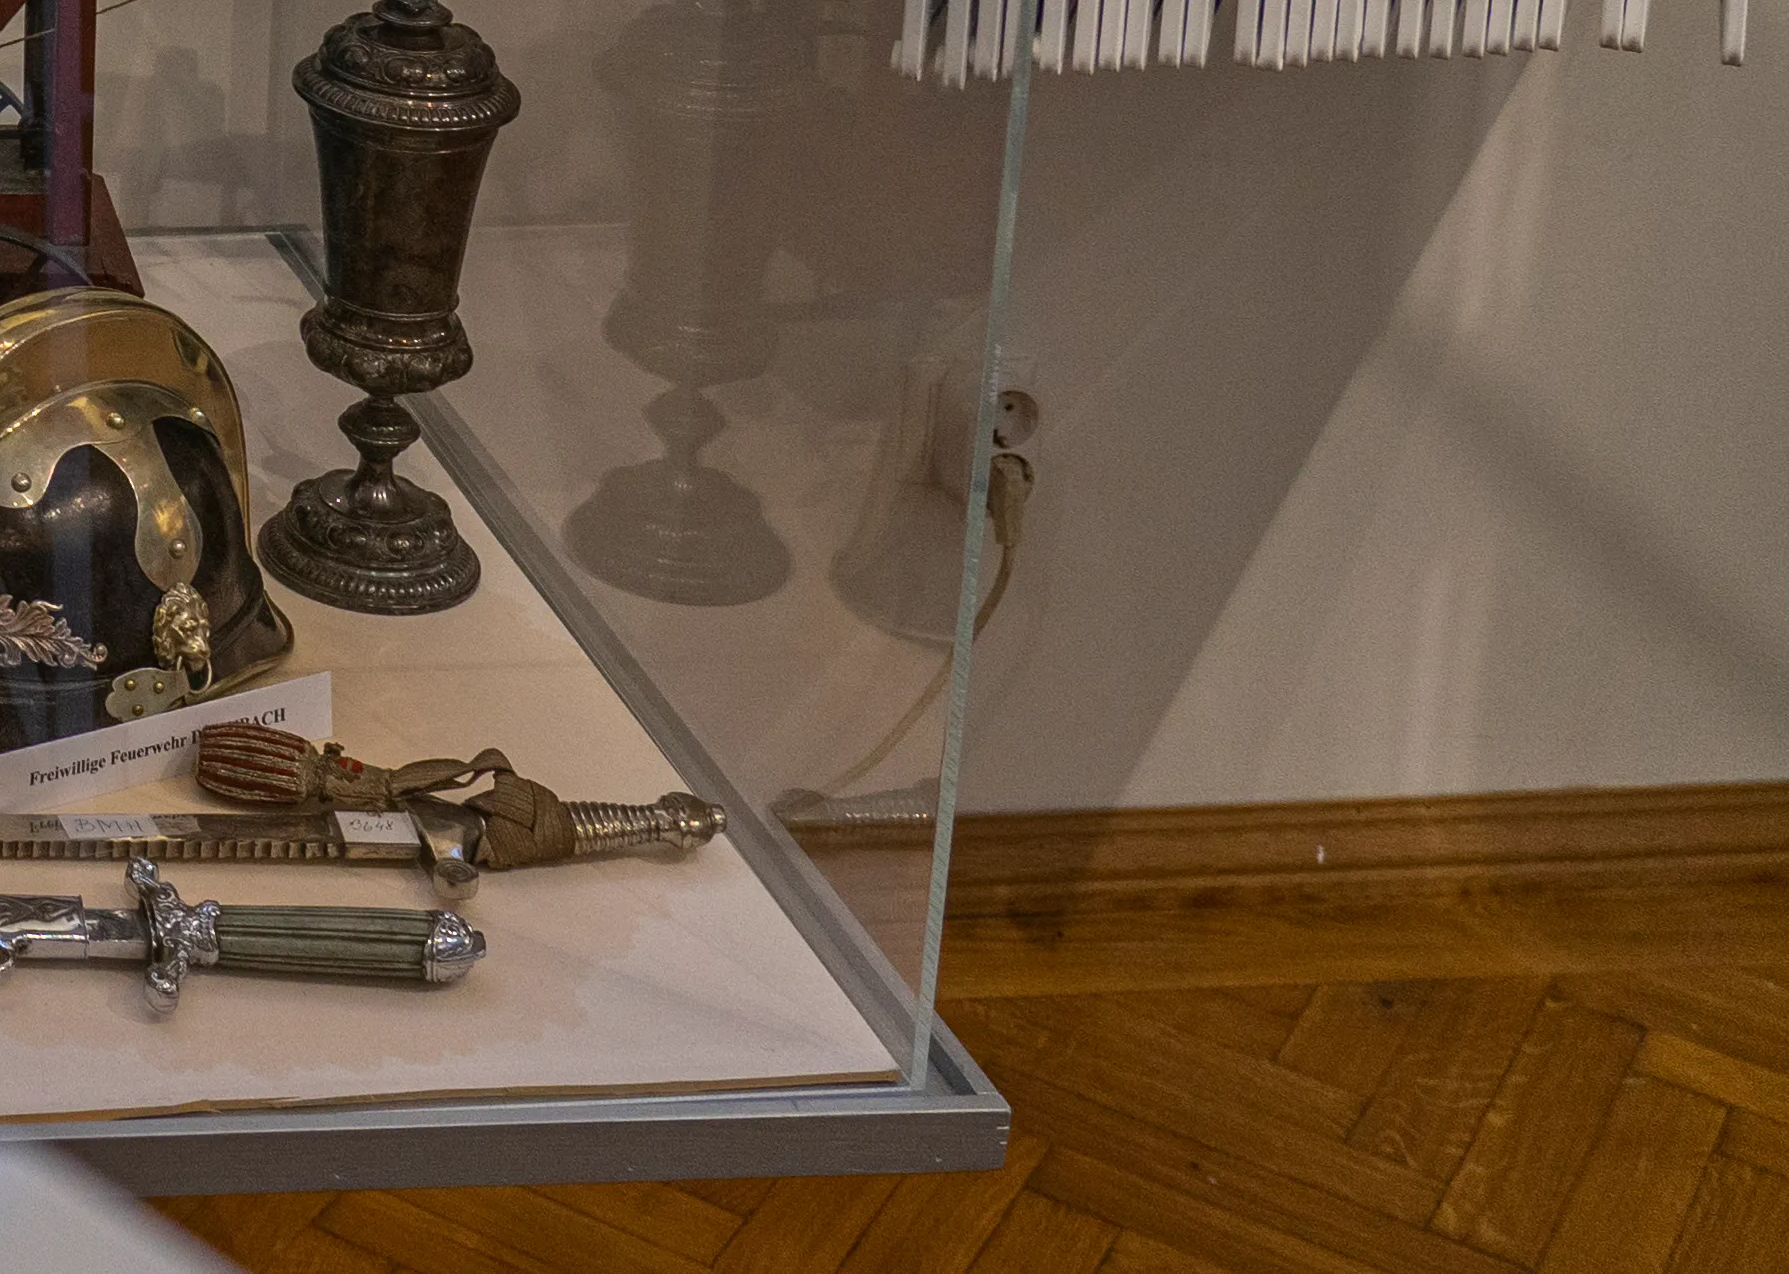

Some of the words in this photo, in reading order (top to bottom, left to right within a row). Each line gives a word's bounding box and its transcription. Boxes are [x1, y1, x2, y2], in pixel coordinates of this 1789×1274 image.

[29, 755, 107, 787] Freiwillige
[110, 734, 188, 766] Feuerwehr
[190, 707, 286, 745] DBACH
